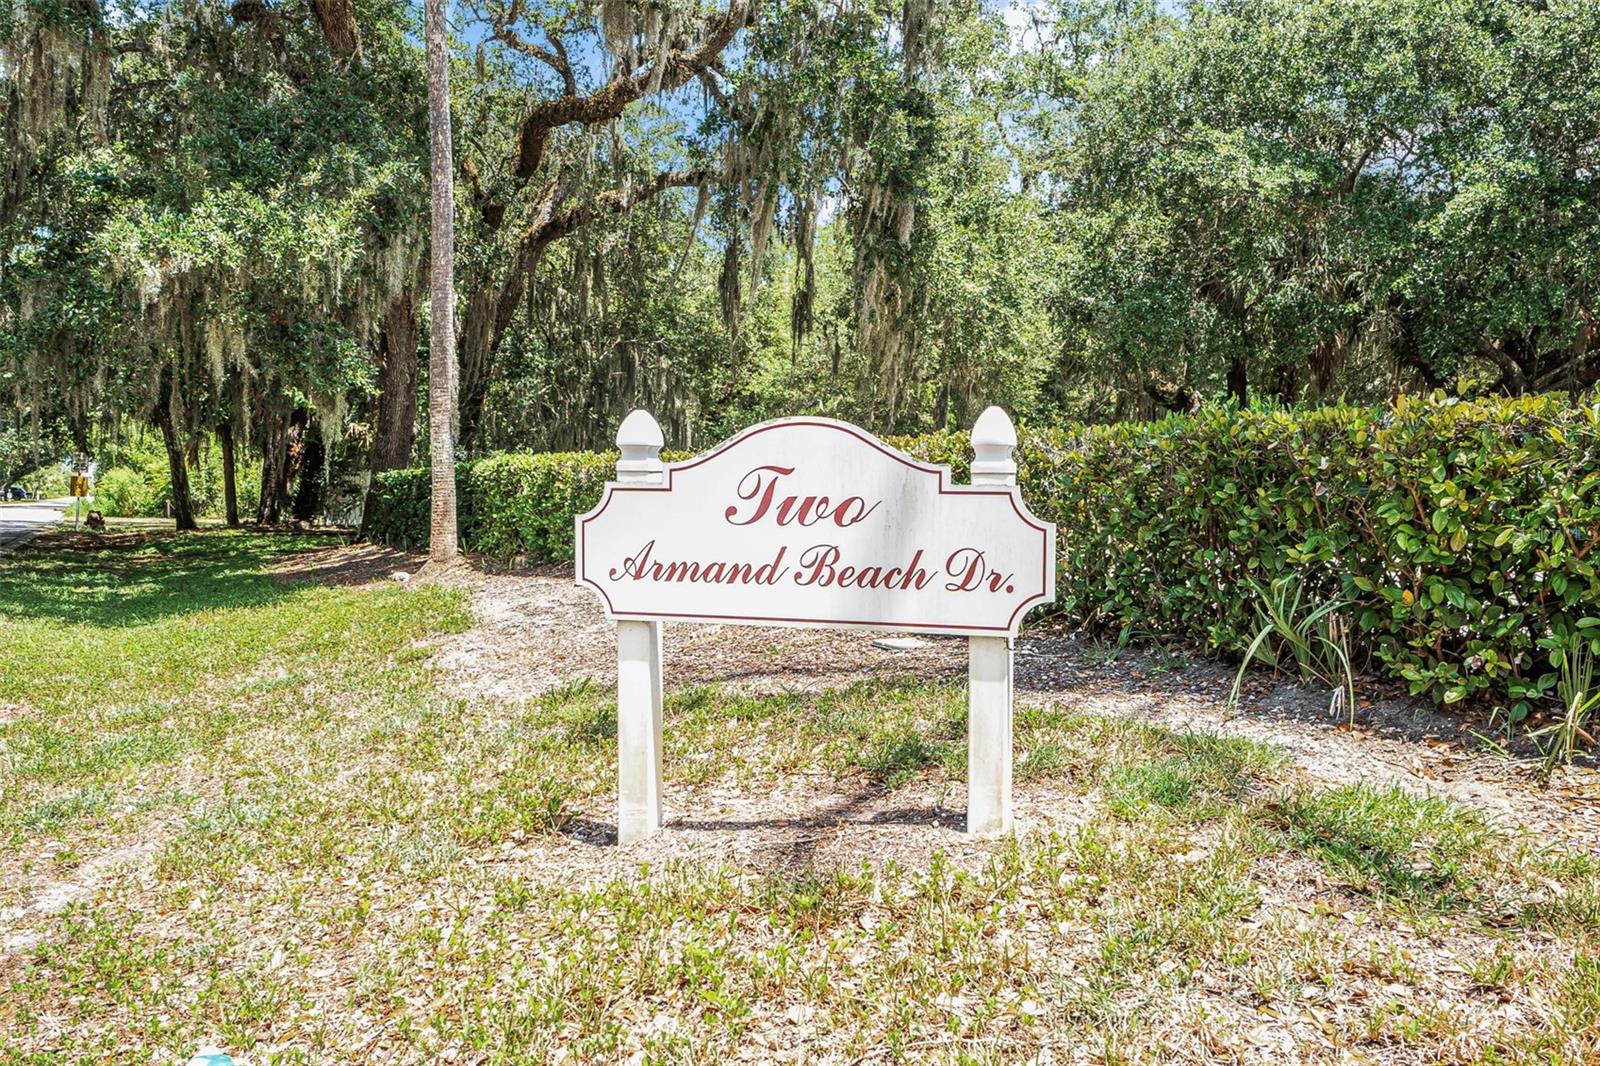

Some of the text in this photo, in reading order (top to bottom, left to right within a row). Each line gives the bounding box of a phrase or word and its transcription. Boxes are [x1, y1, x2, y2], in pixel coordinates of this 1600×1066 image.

[73, 463, 88, 471] 25
[725, 465, 881, 527] Two
[609, 539, 1014, 594] Armand Beach Dr.
